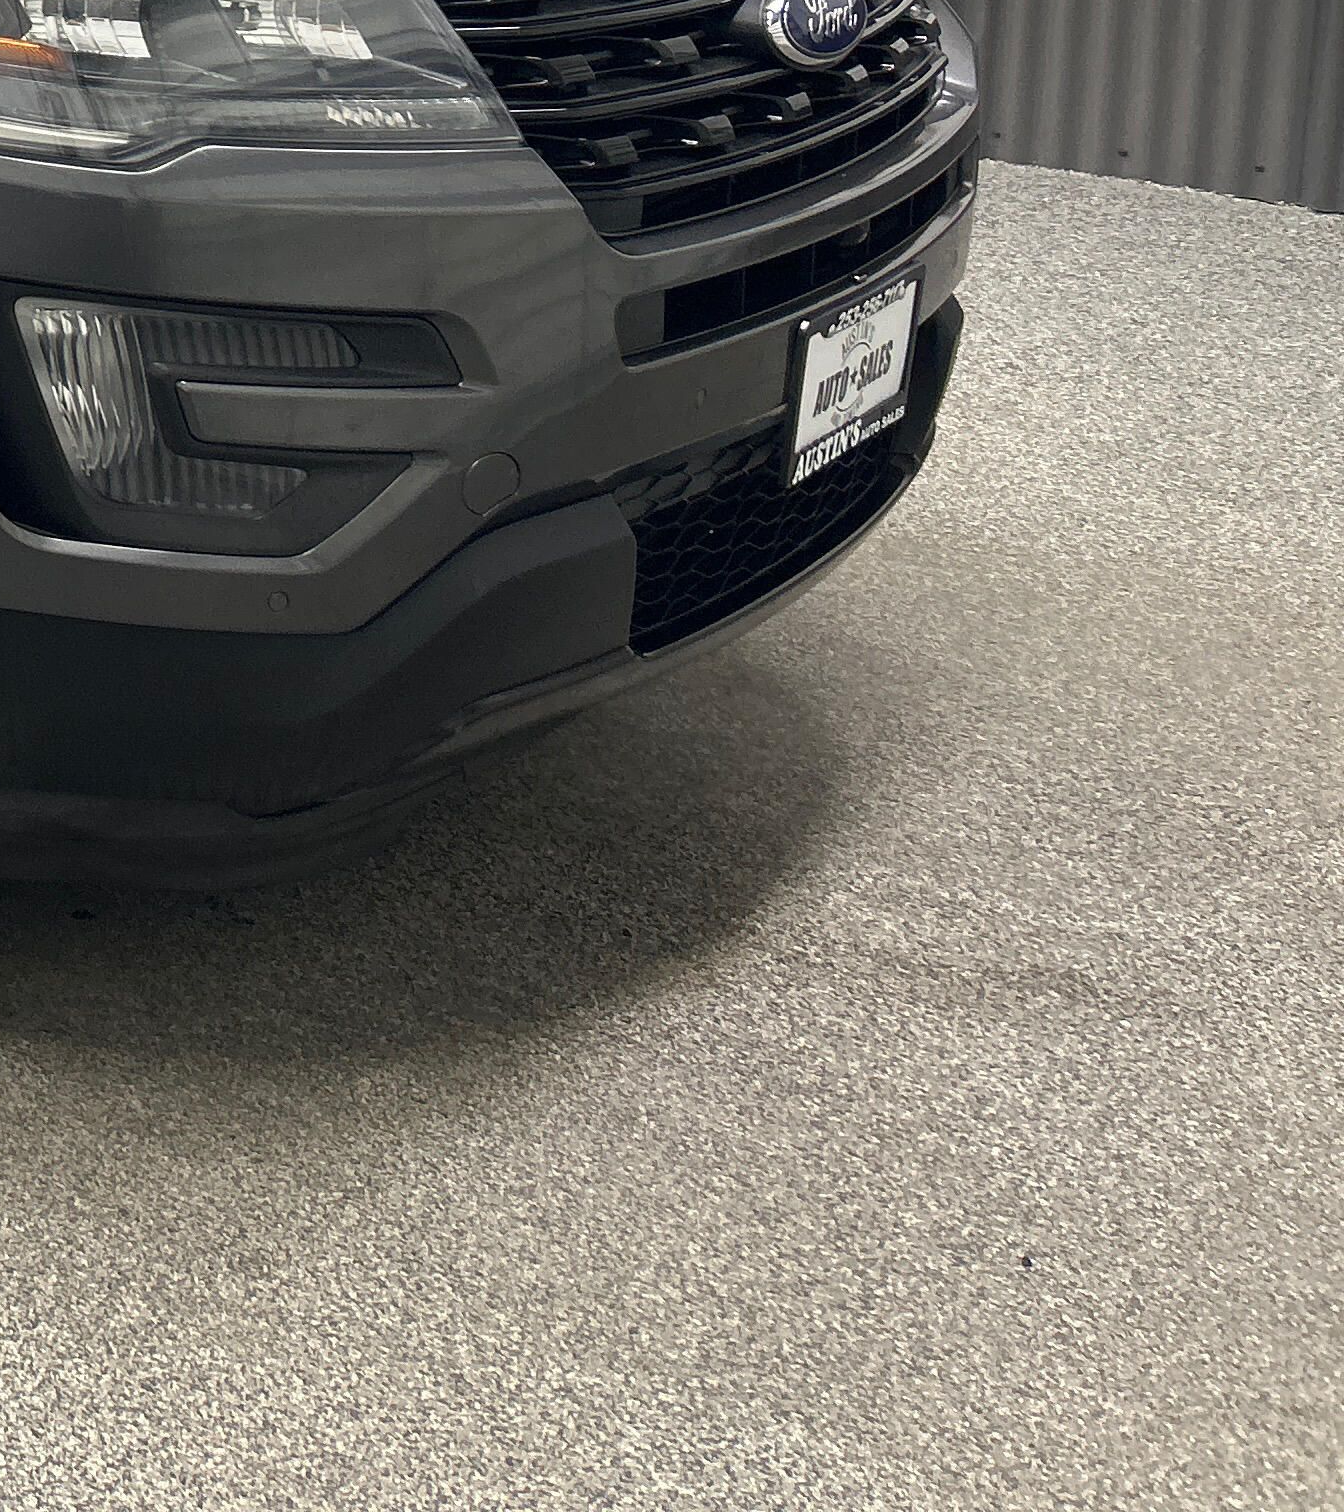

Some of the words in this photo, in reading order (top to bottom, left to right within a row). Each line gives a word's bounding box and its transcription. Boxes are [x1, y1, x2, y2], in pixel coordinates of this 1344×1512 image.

[813, 366, 850, 418] AUTO
[857, 339, 894, 392] SALES
[792, 418, 863, 485] AUSTIN'S
